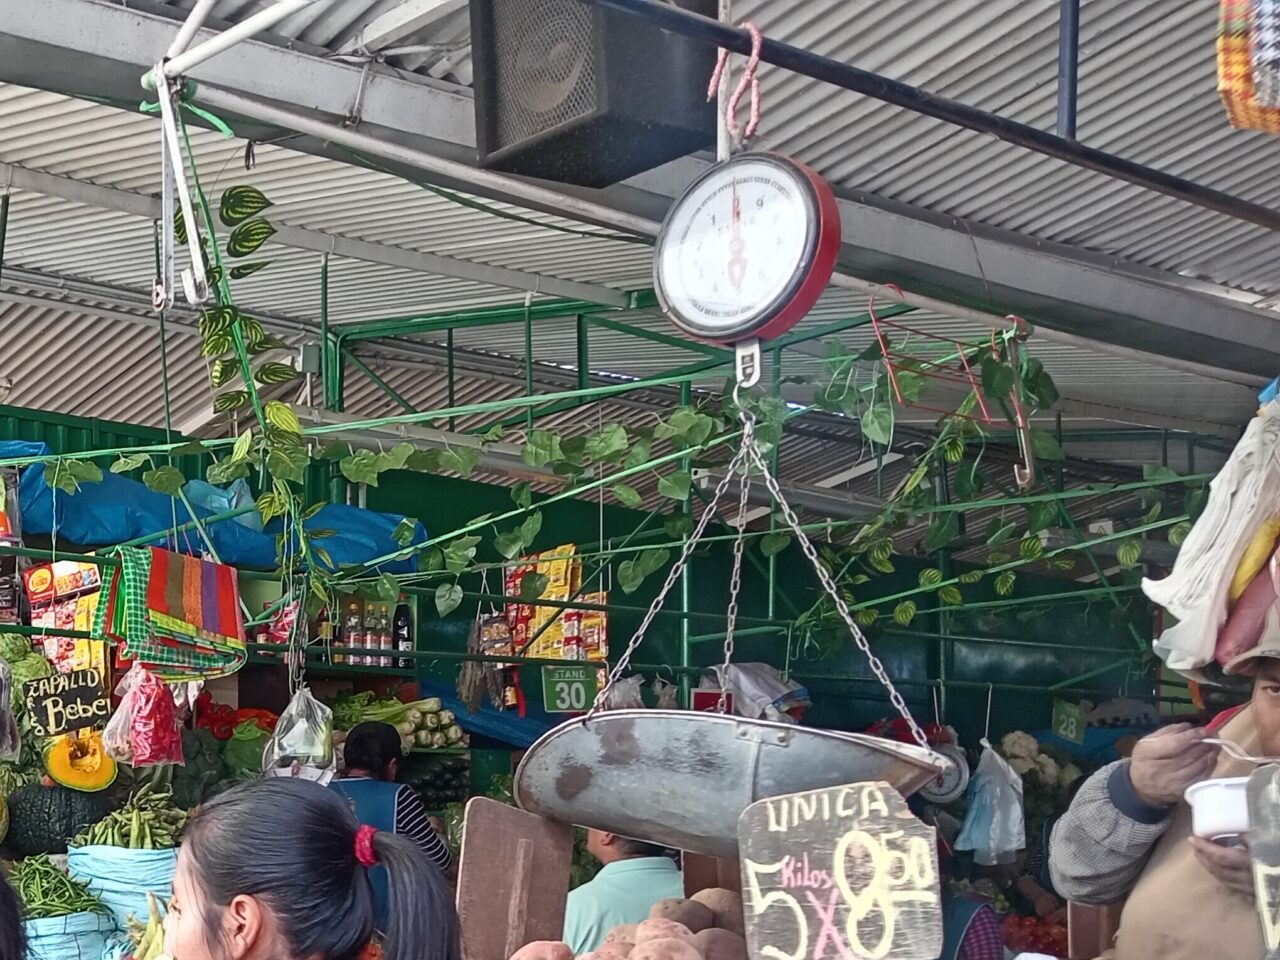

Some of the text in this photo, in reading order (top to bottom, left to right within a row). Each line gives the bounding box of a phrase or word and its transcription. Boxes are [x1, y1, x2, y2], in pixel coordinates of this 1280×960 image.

[553, 669, 586, 679] STAND
[555, 682, 586, 710] 30
[1058, 714, 1077, 739] 28
[766, 786, 889, 832] UNICA
[781, 851, 834, 889] Kilos
